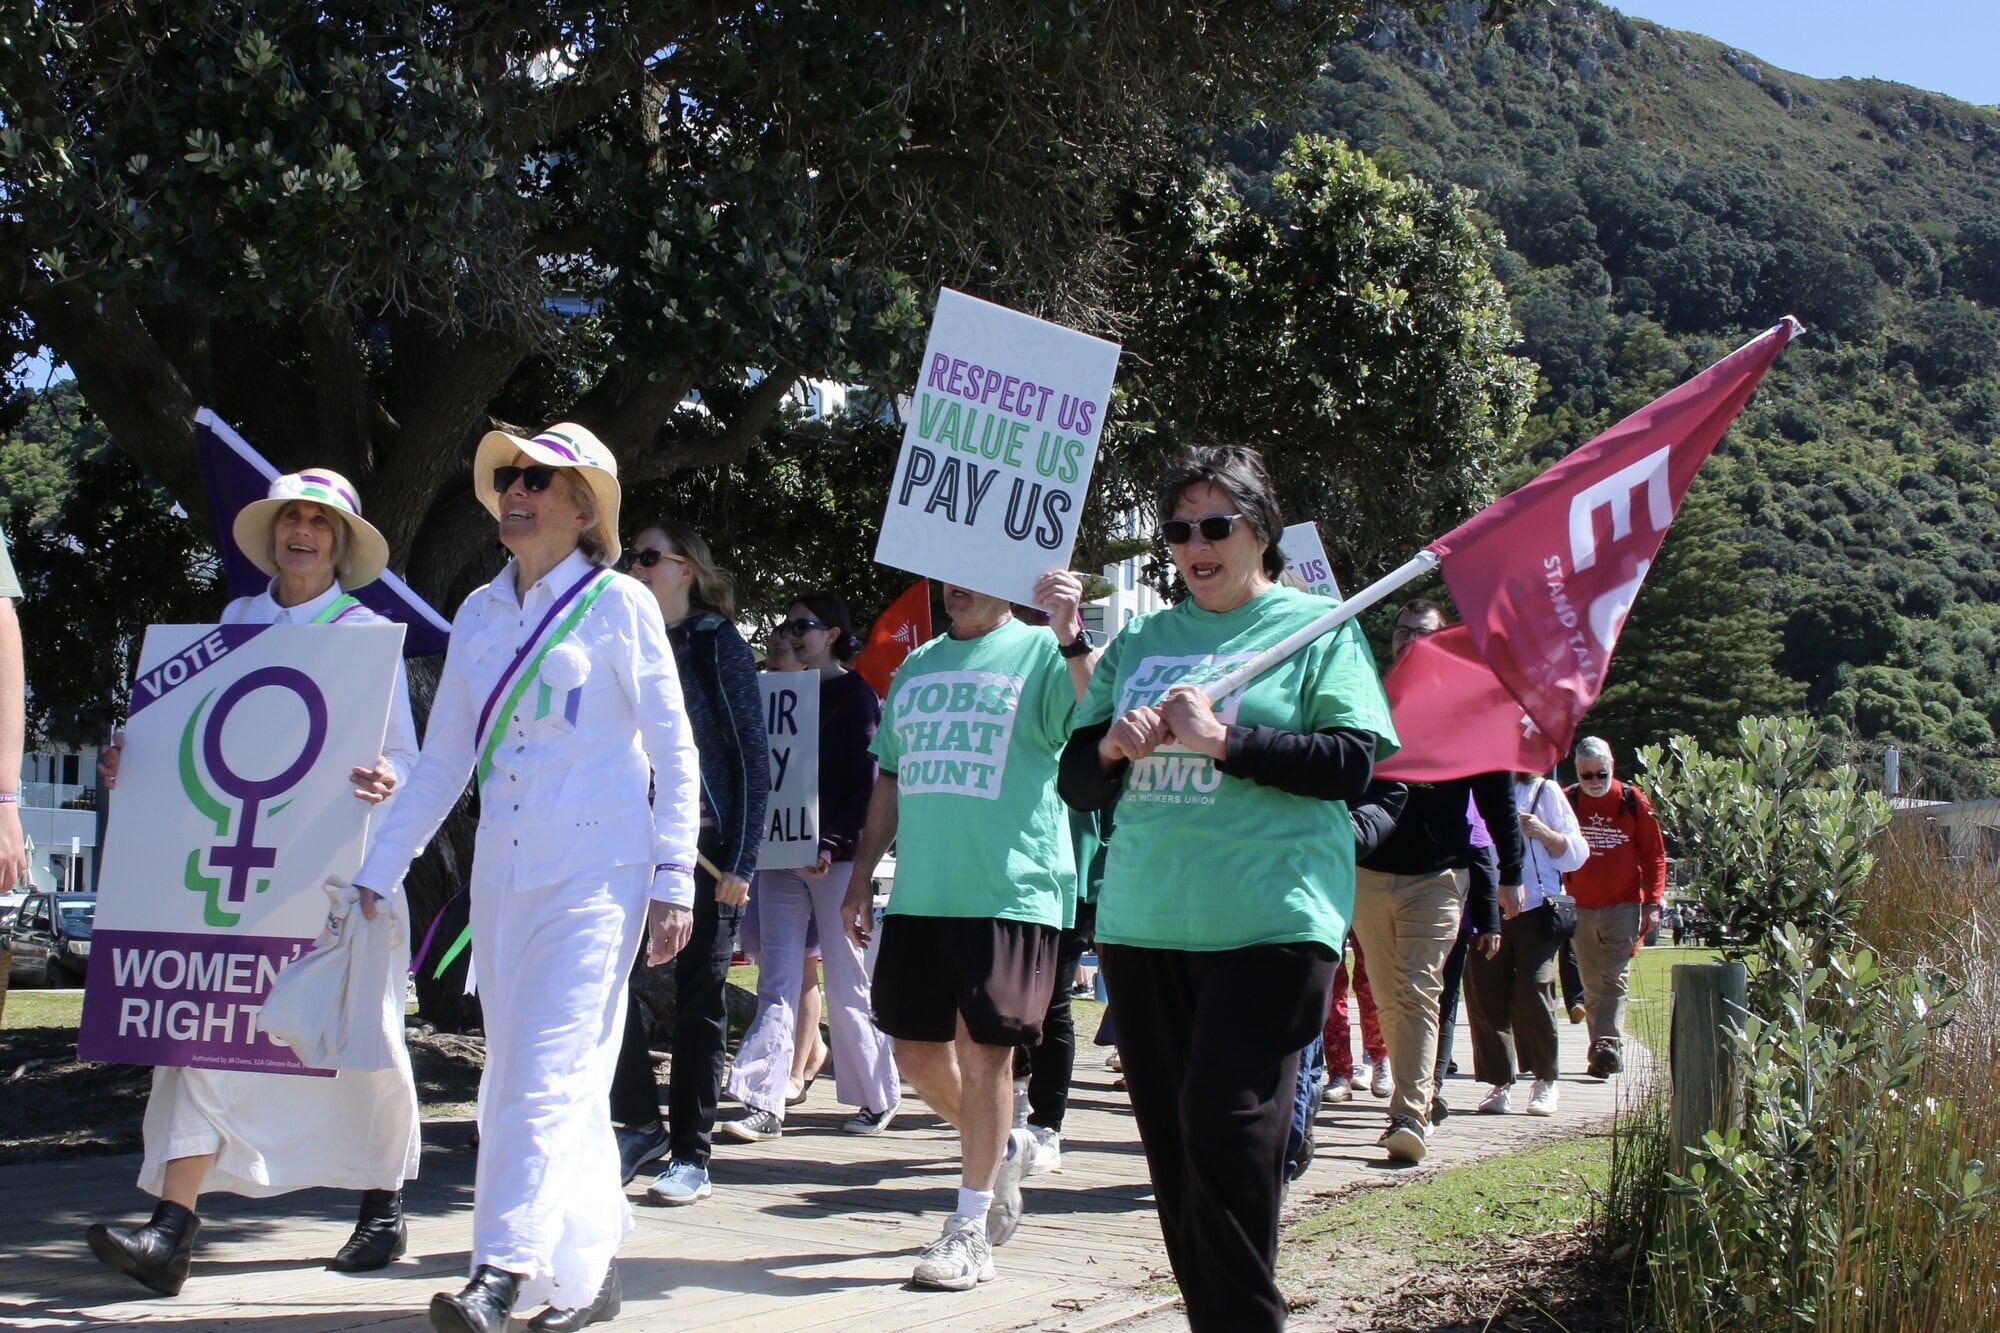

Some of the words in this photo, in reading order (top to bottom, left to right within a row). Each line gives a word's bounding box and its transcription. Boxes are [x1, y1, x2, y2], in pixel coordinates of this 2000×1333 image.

[927, 352, 1054, 421] RESPECT
[1057, 393, 1097, 436] US
[918, 393, 1030, 468] VALUE
[1035, 431, 1084, 484] US
[898, 445, 1000, 526] PAY
[1003, 477, 1072, 550] US
[1299, 559, 1327, 583] US
[1543, 554, 1577, 628] STAND
[141, 631, 229, 698] VOTE
[768, 689, 797, 736] IR
[898, 682, 1013, 718] JOBS
[896, 720, 1004, 757] THAT
[769, 806, 812, 842] ALL
[1184, 796, 1216, 805] UNION
[112, 944, 301, 994] WOMEN'
[118, 998, 290, 1047] RIGHT
[192, 1055, 220, 1063] Authorised
